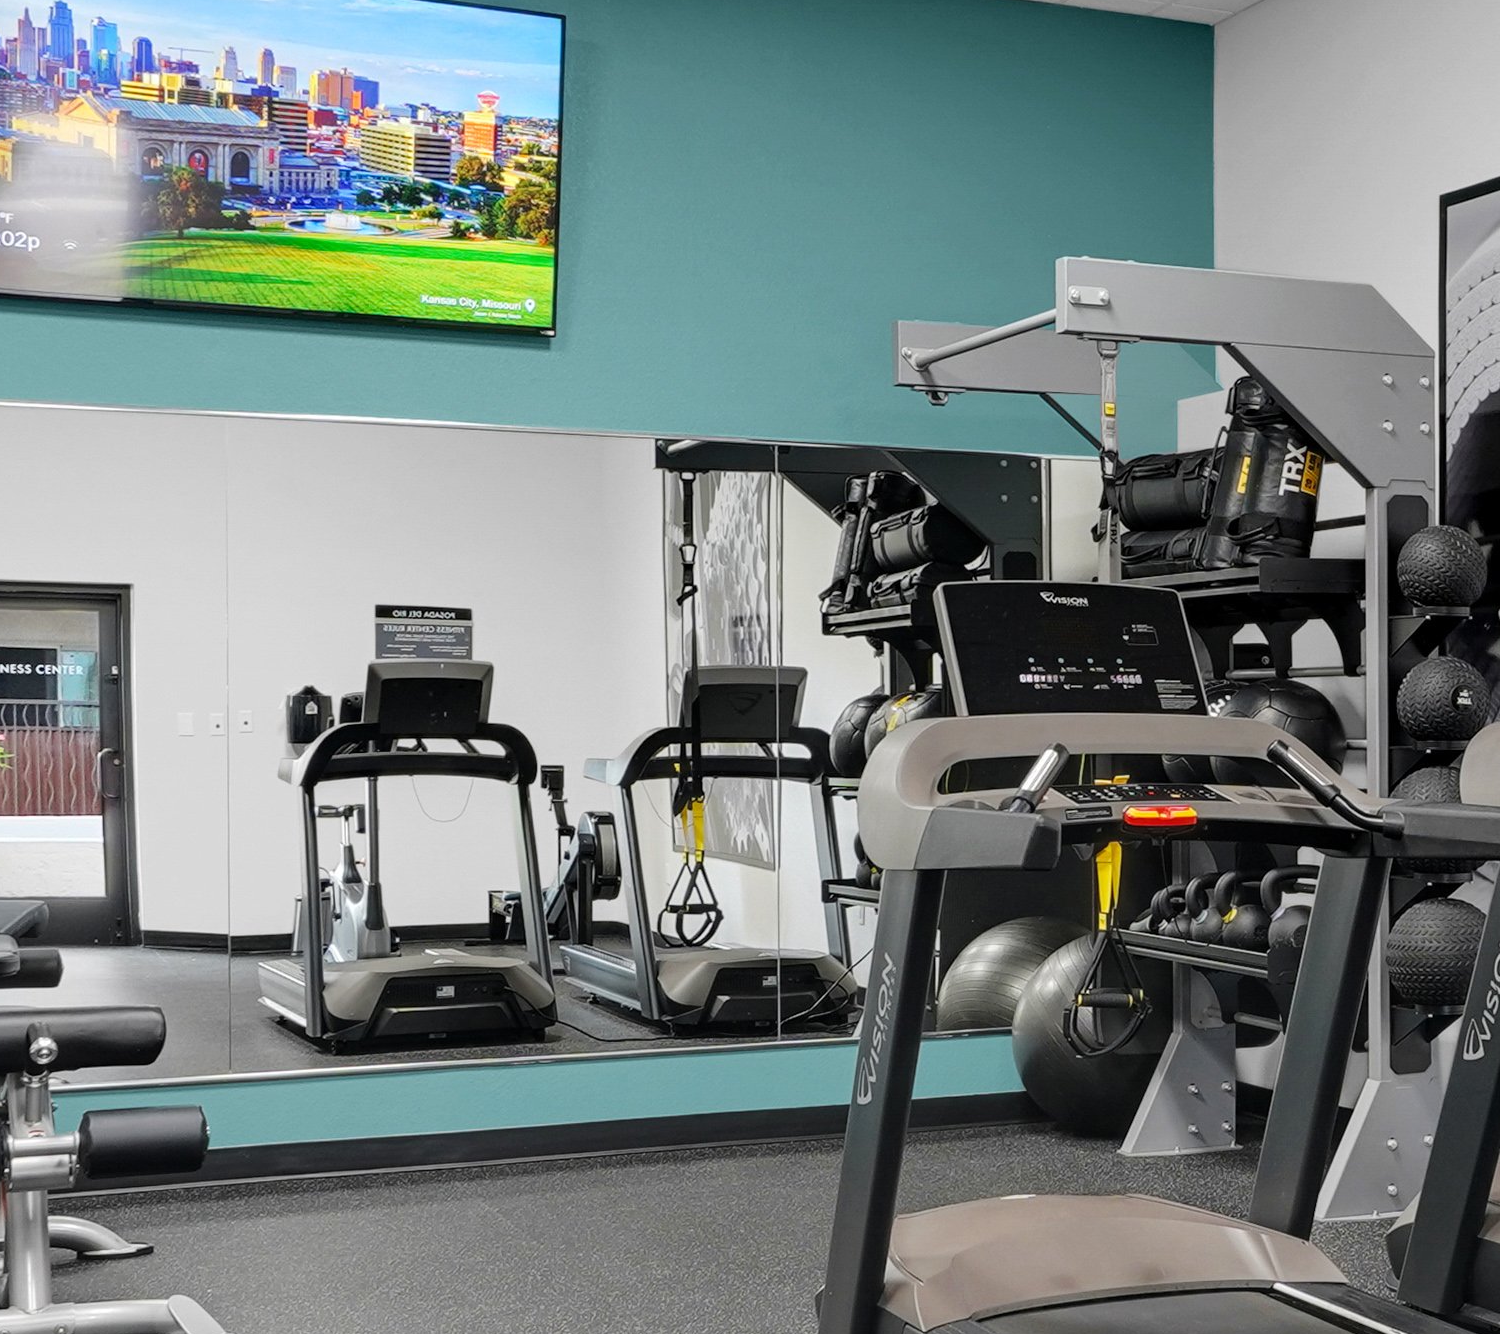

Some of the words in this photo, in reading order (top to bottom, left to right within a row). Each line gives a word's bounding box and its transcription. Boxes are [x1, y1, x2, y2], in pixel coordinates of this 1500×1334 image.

[420, 294, 457, 306] Kansas
[458, 296, 479, 308] City,
[481, 298, 522, 311] Missouri
[1278, 442, 1308, 496] TRX
[1109, 521, 1118, 545] TRX
[35, 664, 84, 676] CENTER
[868, 952, 893, 1083] VISION
